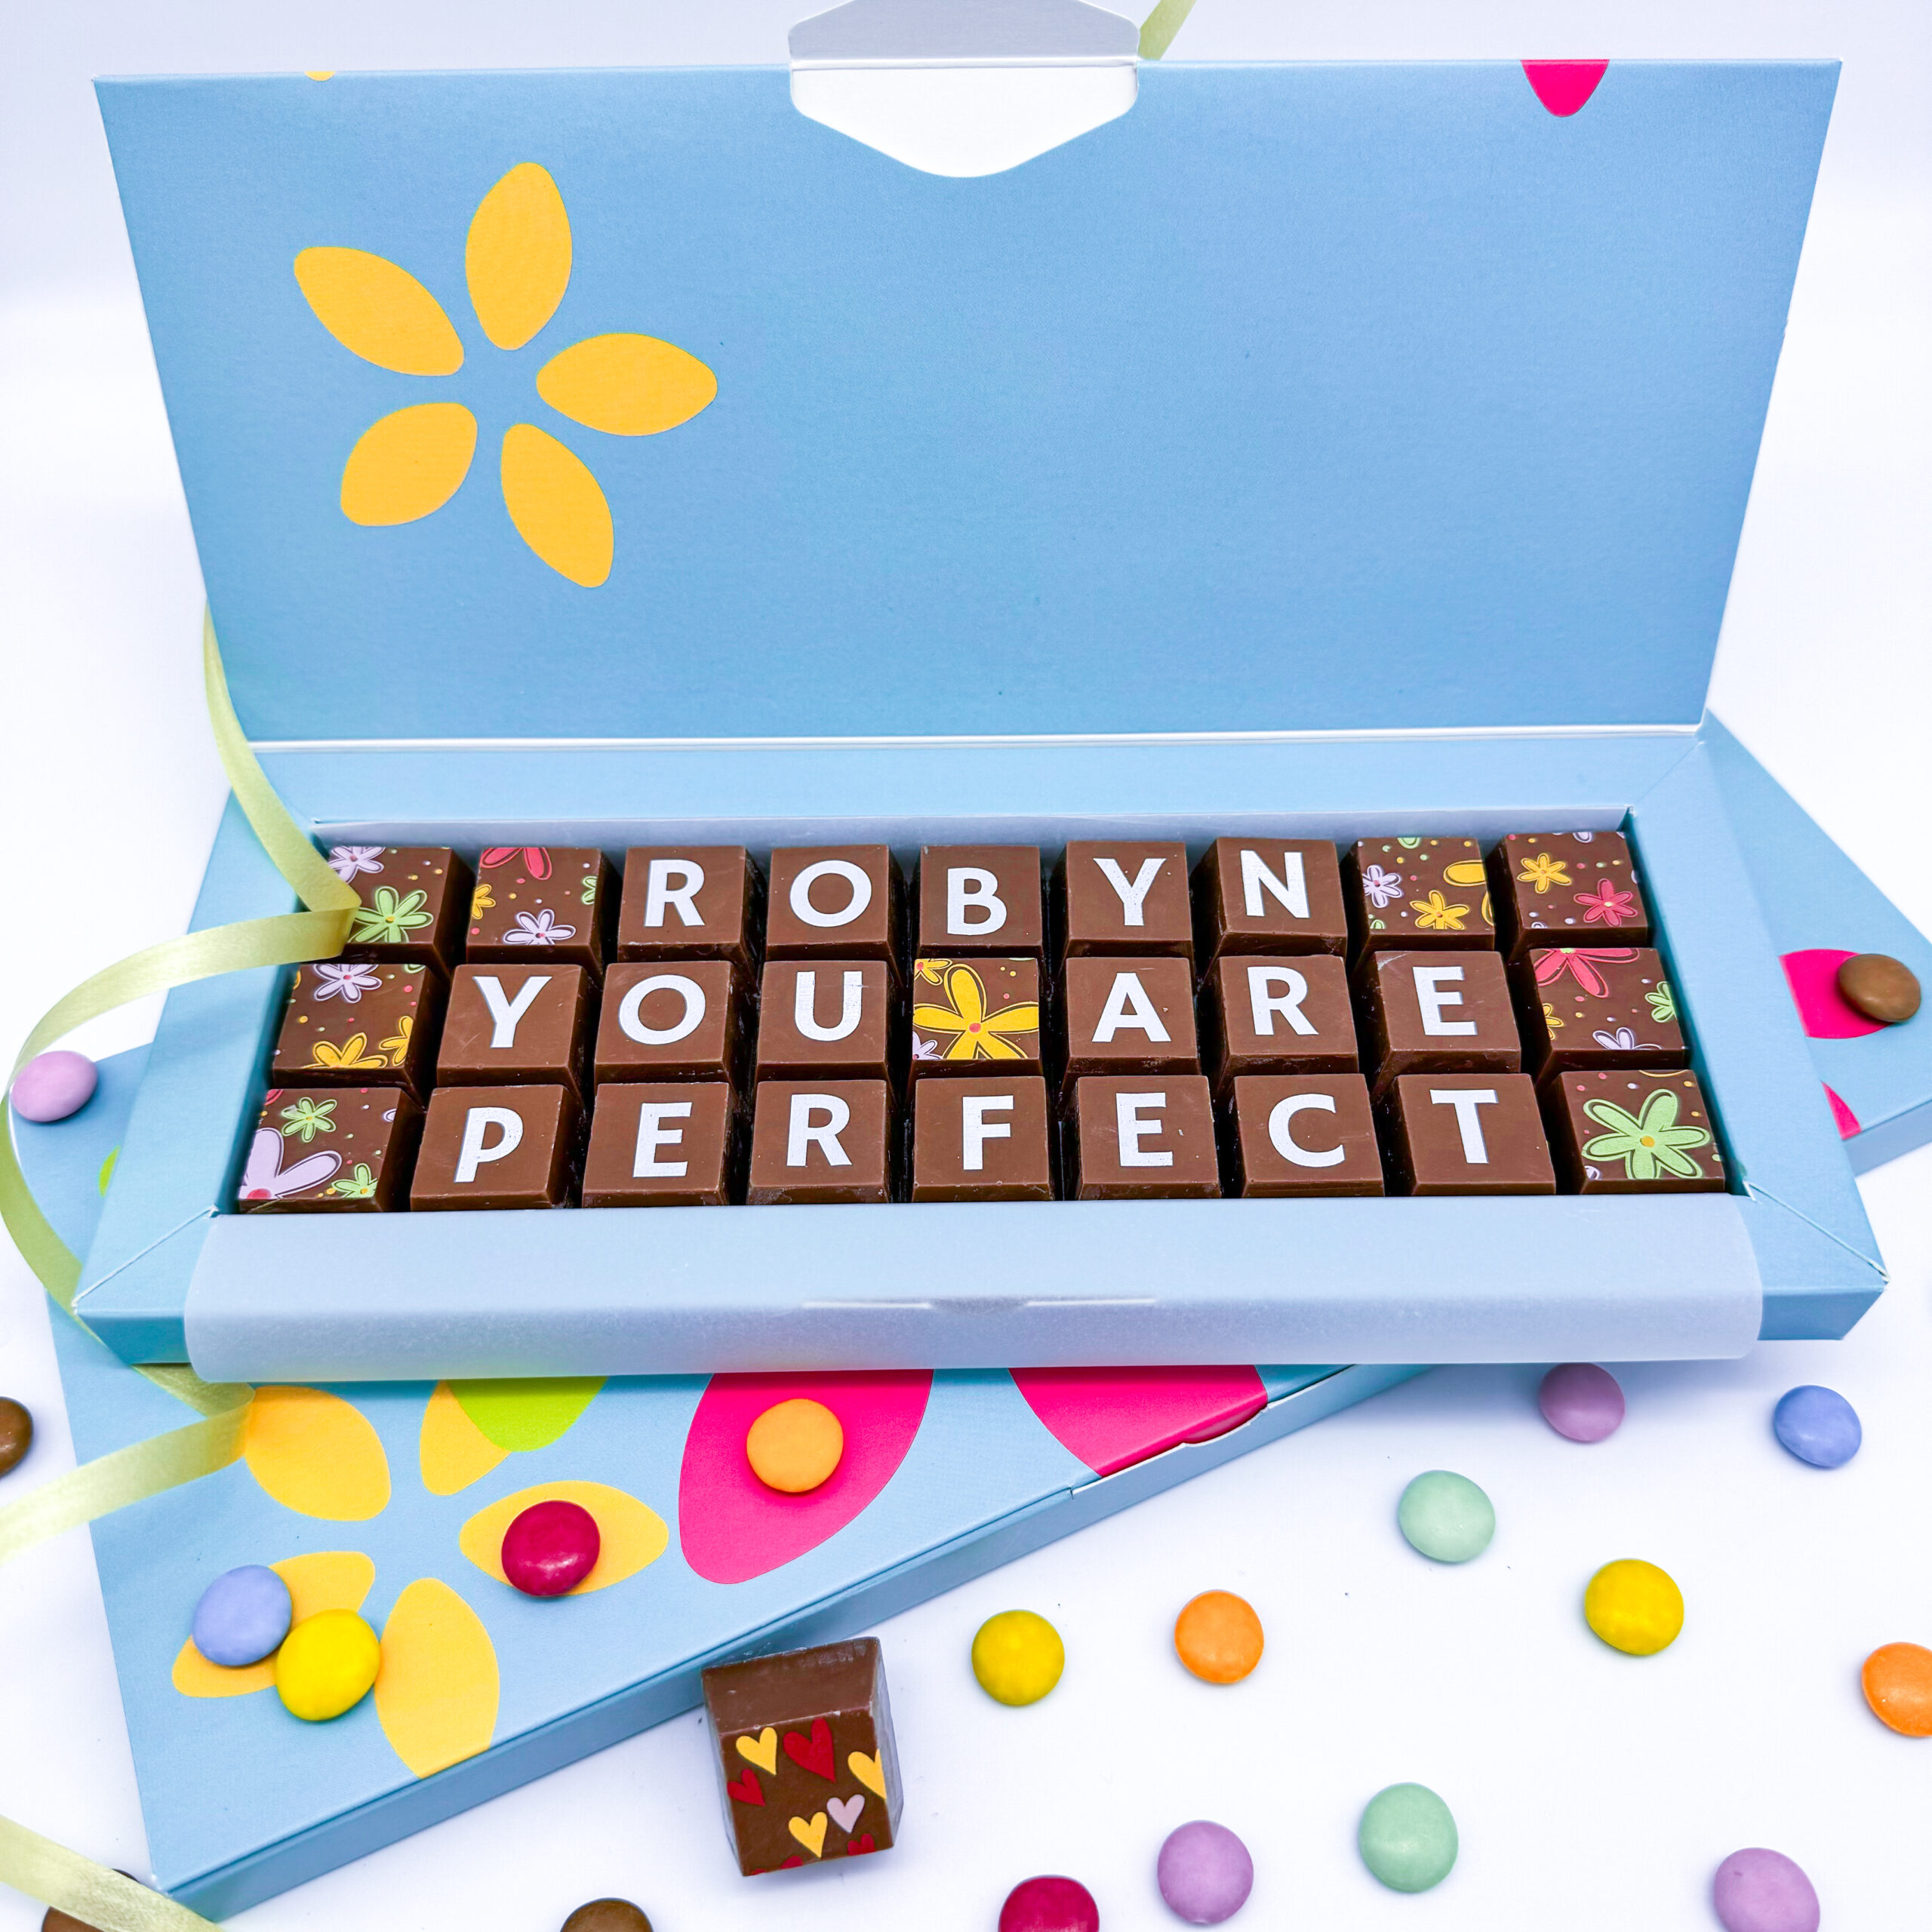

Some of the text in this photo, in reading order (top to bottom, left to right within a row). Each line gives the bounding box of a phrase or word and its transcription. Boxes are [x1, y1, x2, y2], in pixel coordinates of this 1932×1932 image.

[644, 850, 1309, 936] ROBYN
[473, 966, 1478, 1048] YOU ARE
[454, 1089, 1498, 1183] PERFECT
